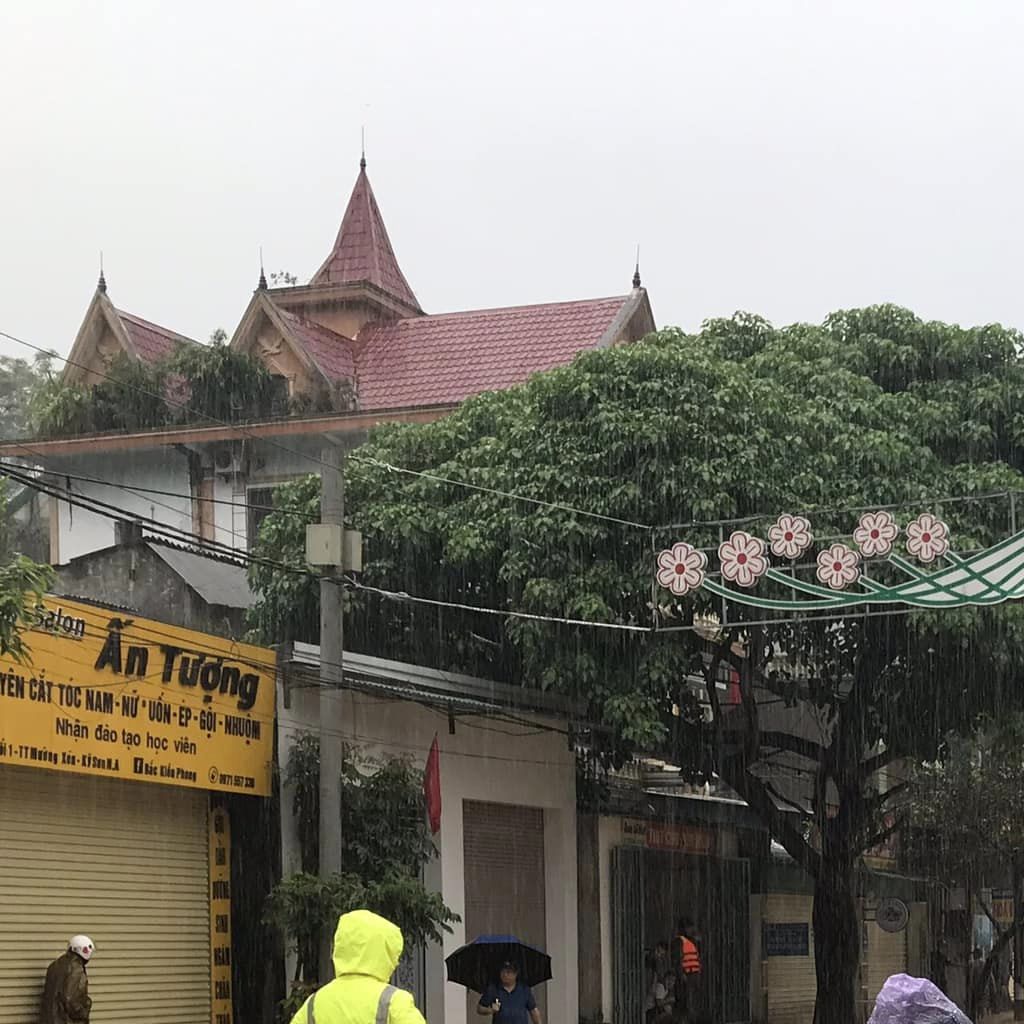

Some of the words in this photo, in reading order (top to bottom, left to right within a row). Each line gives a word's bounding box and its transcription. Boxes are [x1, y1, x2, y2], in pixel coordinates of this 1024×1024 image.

[95, 617, 149, 677] Ấn
[159, 645, 260, 710] Tượng
[29, 668, 53, 703] CẮT
[58, 677, 81, 708] TÓC
[85, 688, 114, 714] NAM
[149, 691, 171, 725] UỐN
[178, 699, 192, 728] ÉP
[199, 706, 216, 739] GỘI
[224, 712, 260, 745] NHUỘM
[56, 717, 89, 742] Nhận
[95, 724, 117, 743] đào
[122, 729, 141, 751] tạo
[146, 731, 168, 754] học
[174, 737, 197, 755] viên
